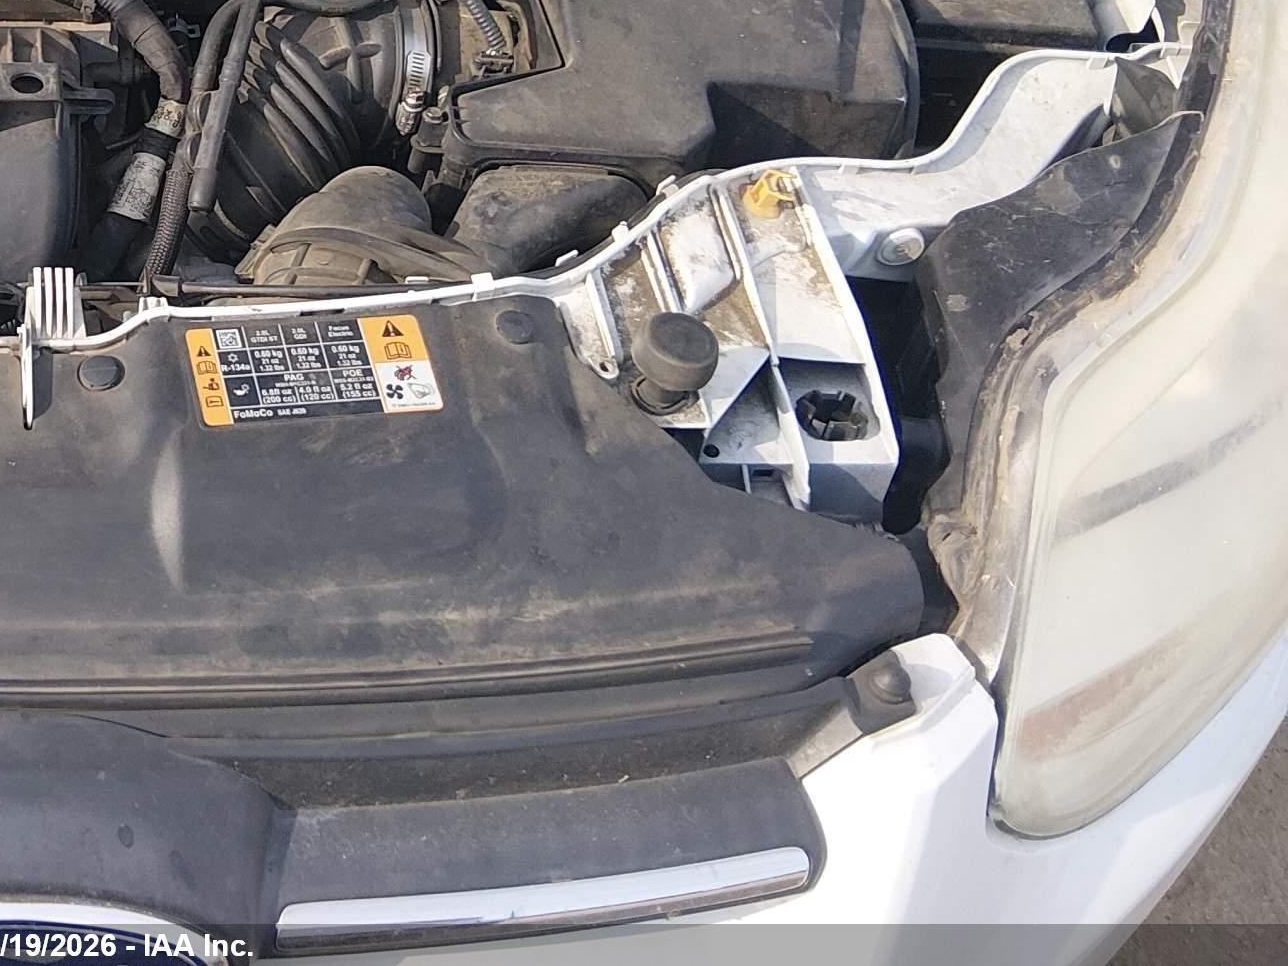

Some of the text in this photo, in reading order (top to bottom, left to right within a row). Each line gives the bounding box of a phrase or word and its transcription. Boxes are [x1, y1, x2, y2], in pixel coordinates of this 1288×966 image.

[308, 347, 319, 355] kg
[348, 344, 360, 353] kg
[272, 350, 283, 358] kg
[220, 363, 250, 372] R-134a
[283, 373, 304, 381] PAG
[342, 369, 363, 377] POE
[233, 408, 273, 419] FoMoCo
